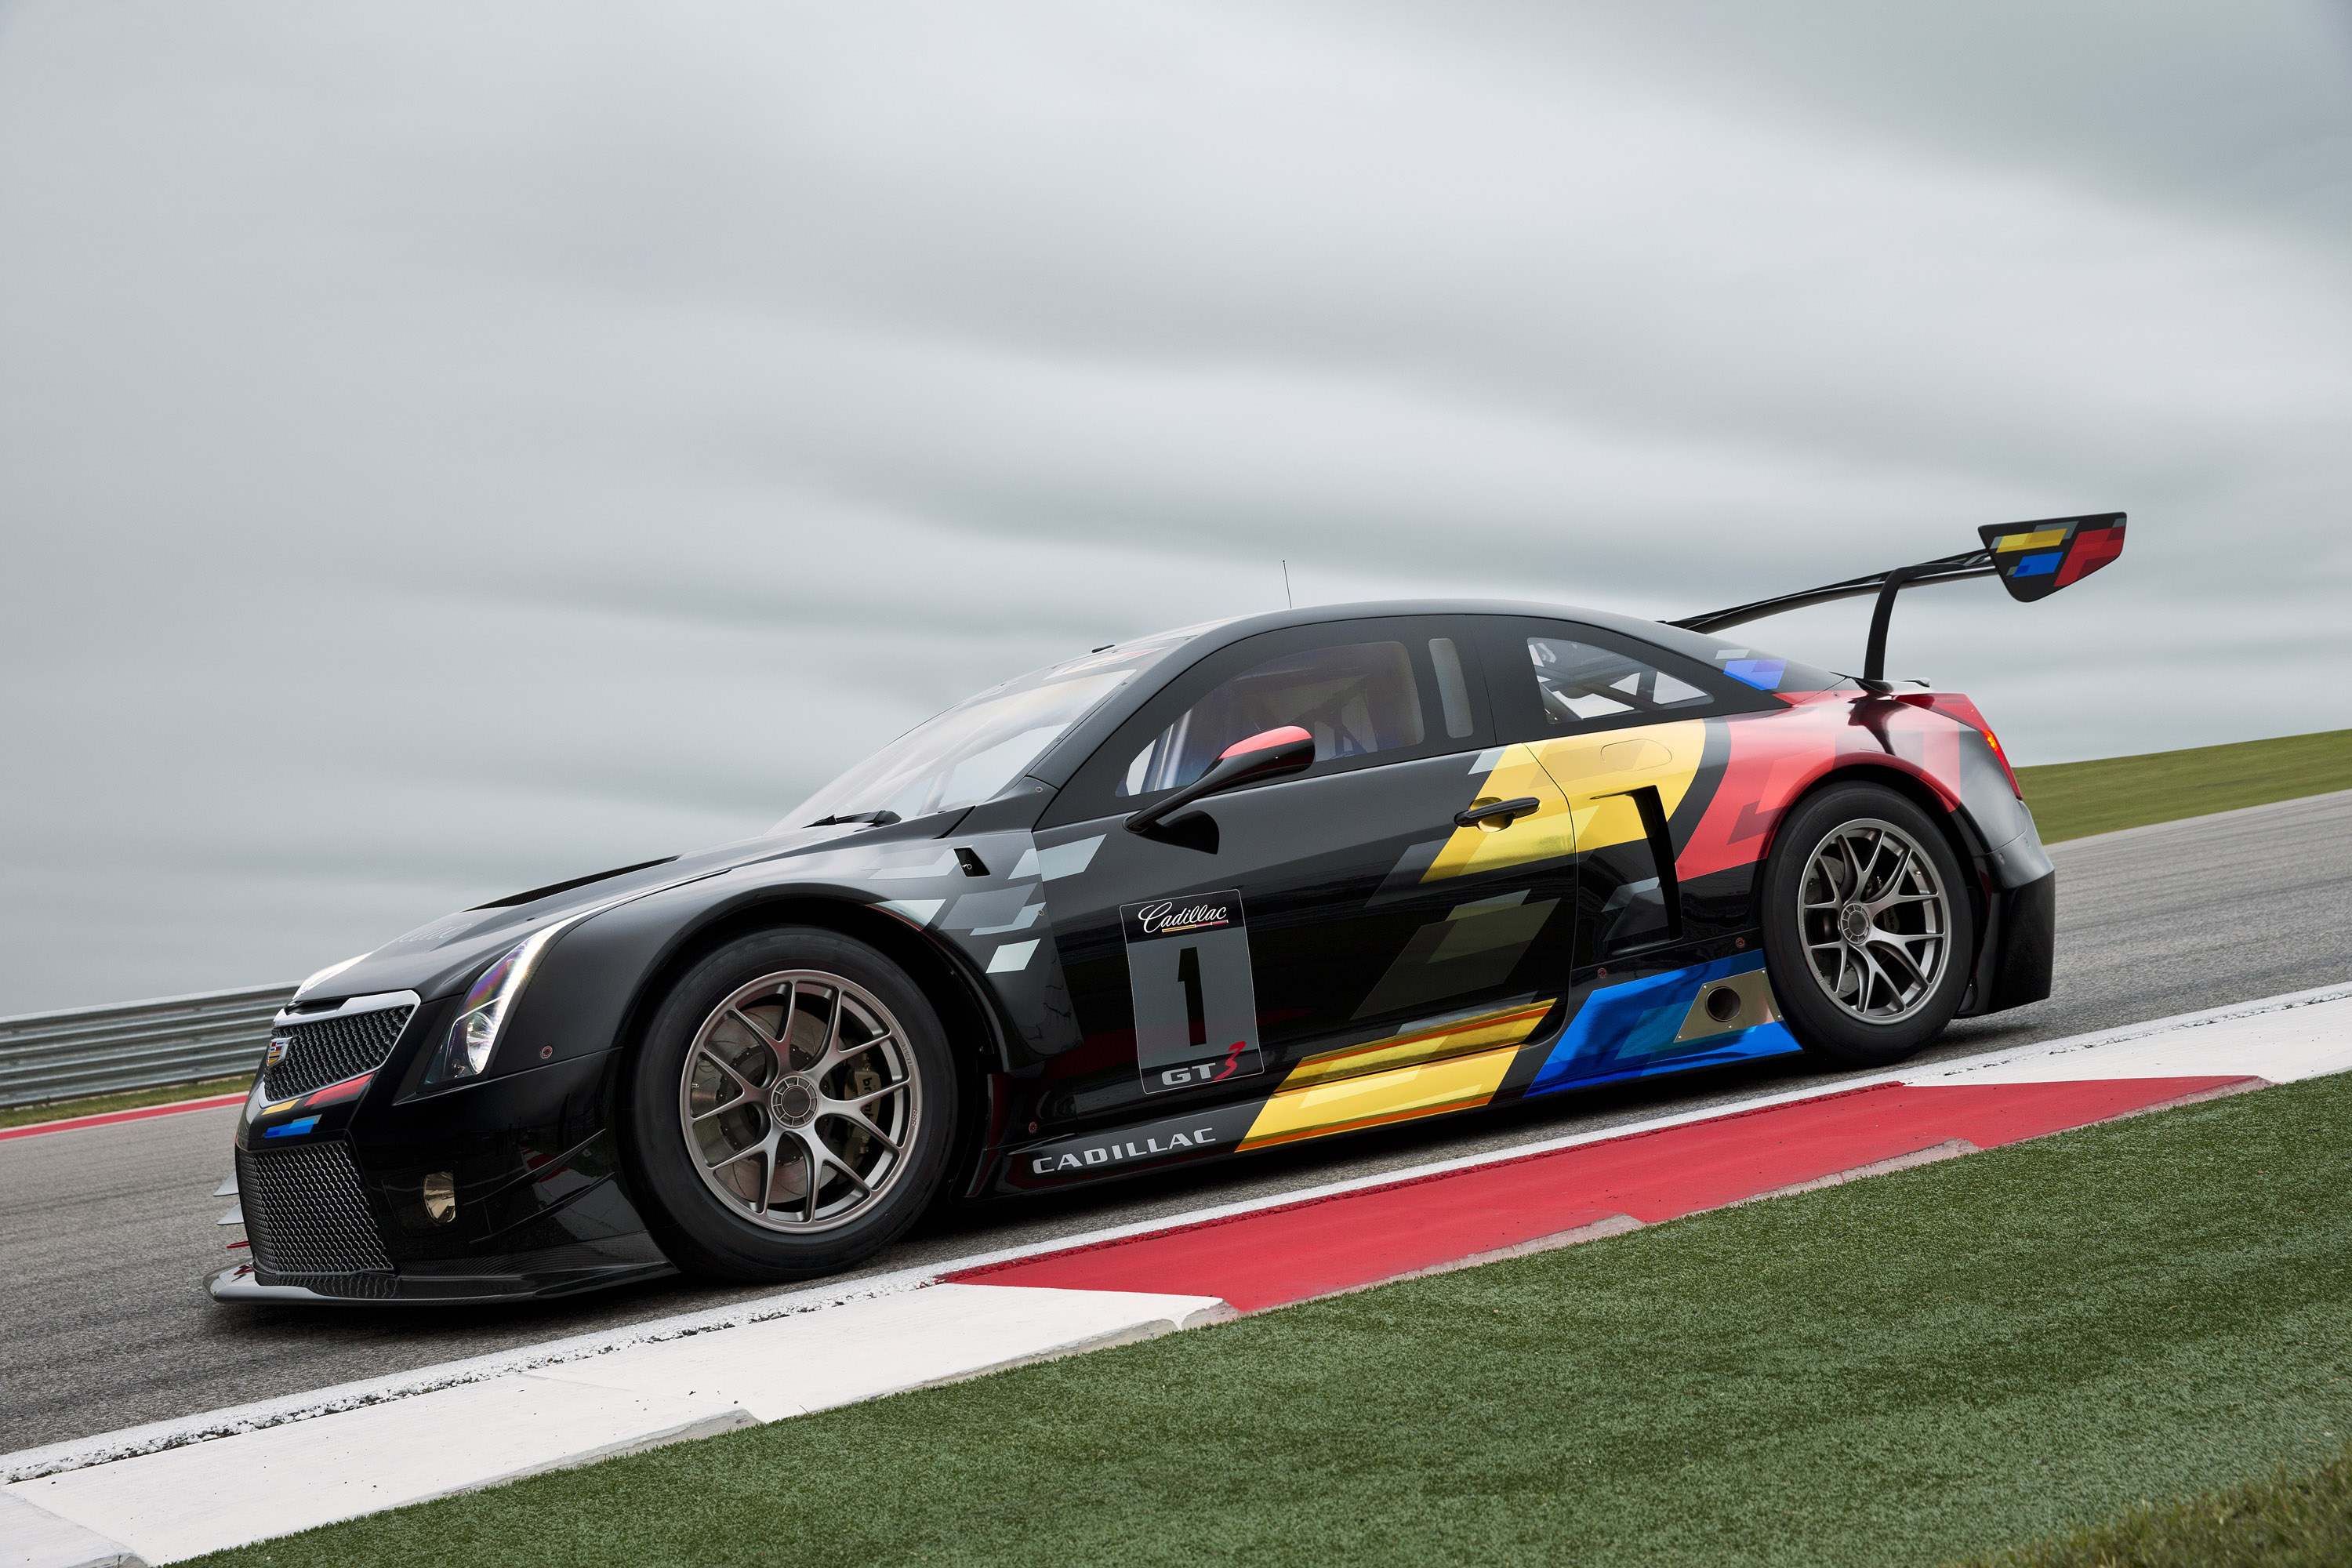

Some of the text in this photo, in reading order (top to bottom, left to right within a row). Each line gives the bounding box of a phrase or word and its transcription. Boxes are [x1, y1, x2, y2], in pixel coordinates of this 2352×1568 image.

[1138, 902, 1227, 934] Cadillac
[1178, 946, 1207, 1047] 1
[1161, 1040, 1247, 1086] GT3
[1033, 1127, 1216, 1174] CADILLAC
